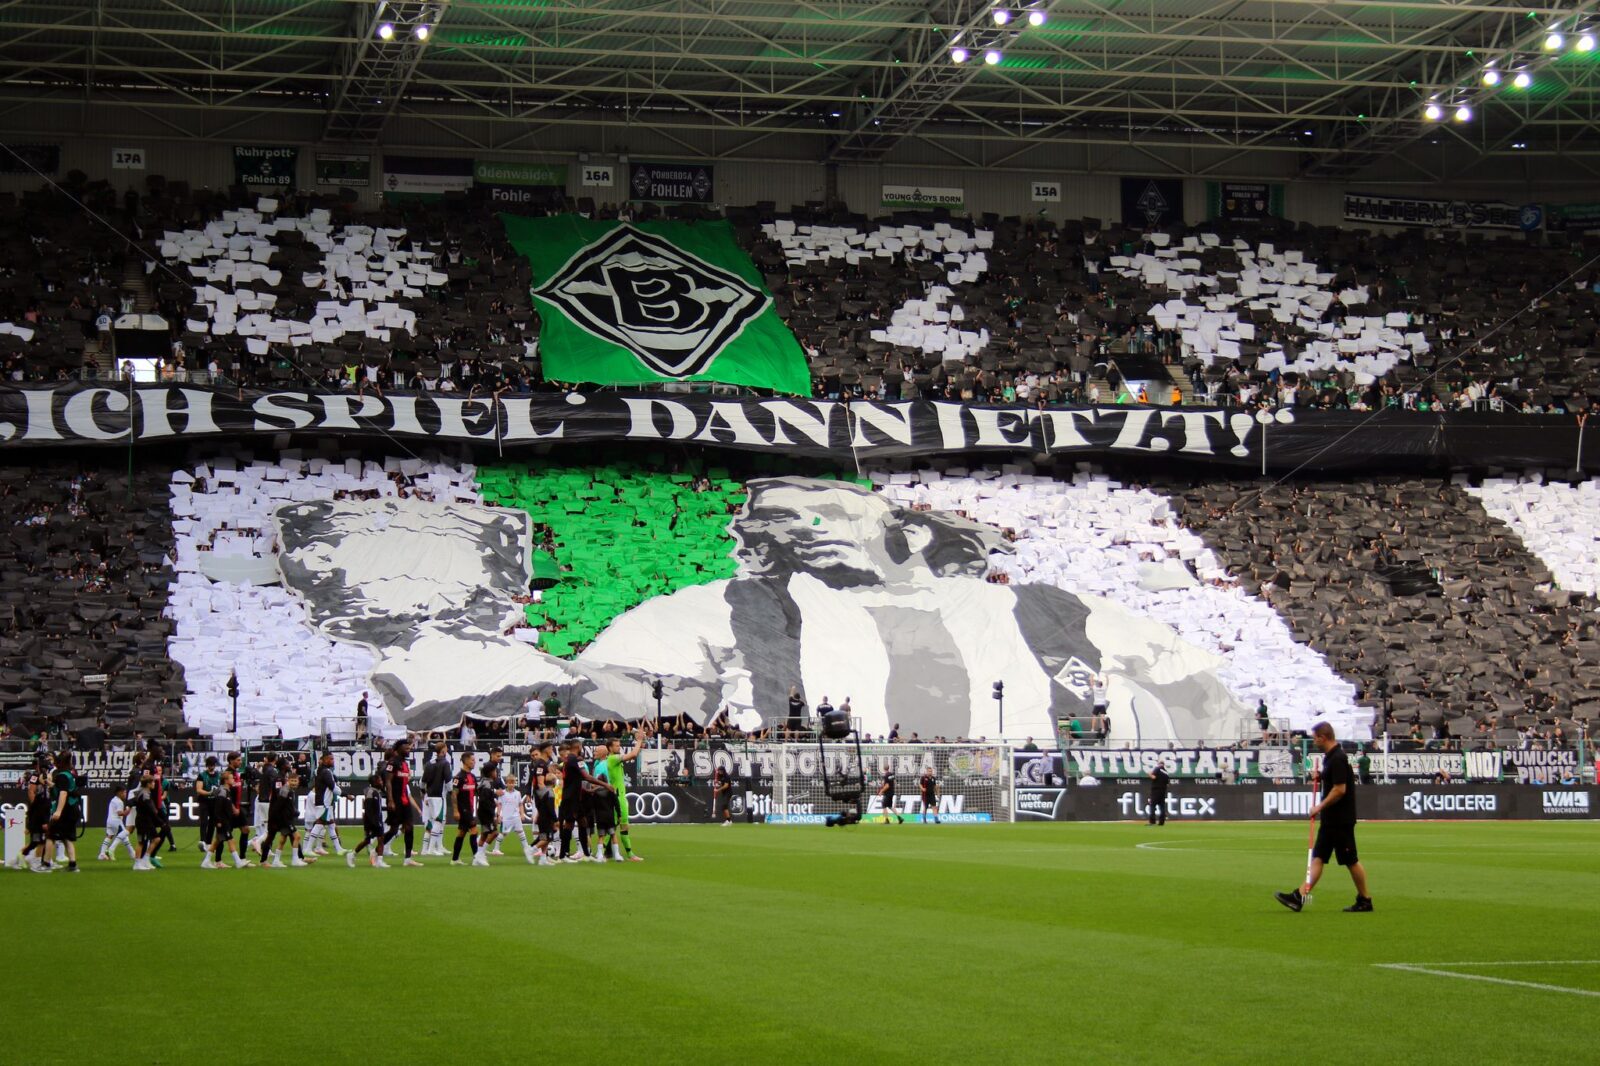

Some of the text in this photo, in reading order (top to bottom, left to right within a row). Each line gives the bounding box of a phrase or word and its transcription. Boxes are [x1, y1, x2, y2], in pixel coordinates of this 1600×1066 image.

[116, 153, 141, 164] 17A
[235, 147, 295, 159] Ruhrpott-
[242, 175, 276, 184] Fohlen
[586, 171, 610, 181] 16A
[651, 184, 693, 198] FOHLEN
[884, 193, 911, 201] YOUNG
[1035, 186, 1057, 197] 15A
[1346, 196, 1448, 222] HALTERN
[621, 397, 913, 448] DANN
[71, 751, 135, 770] ILLICH
[1503, 751, 1577, 766] PUMUCKL
[1018, 790, 1042, 801] inter
[1543, 791, 1574, 807] LVM
[867, 794, 964, 814] ELTN
[1020, 801, 1053, 809] wetten
[1423, 794, 1497, 811] KYOCERA
